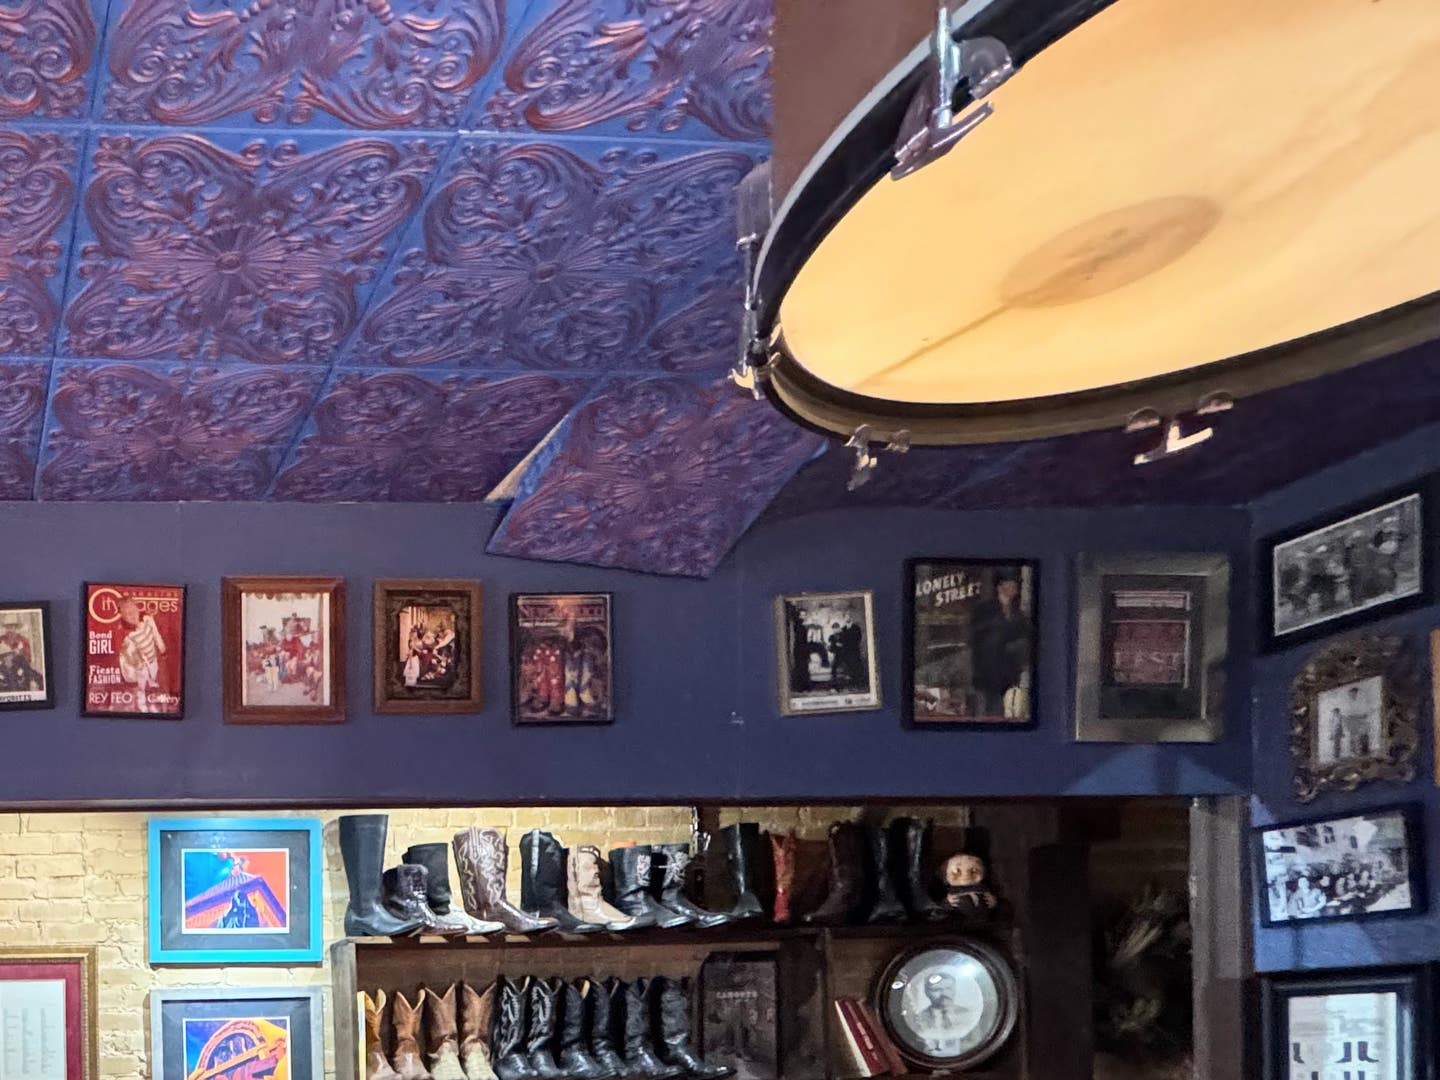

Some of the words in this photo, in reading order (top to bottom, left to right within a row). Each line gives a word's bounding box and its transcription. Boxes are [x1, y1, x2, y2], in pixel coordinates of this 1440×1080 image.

[915, 571, 965, 597] LONELY
[89, 631, 113, 639] Bond
[89, 640, 115, 654] GIRL
[89, 692, 108, 704] REY
[110, 692, 133, 704] FEO
